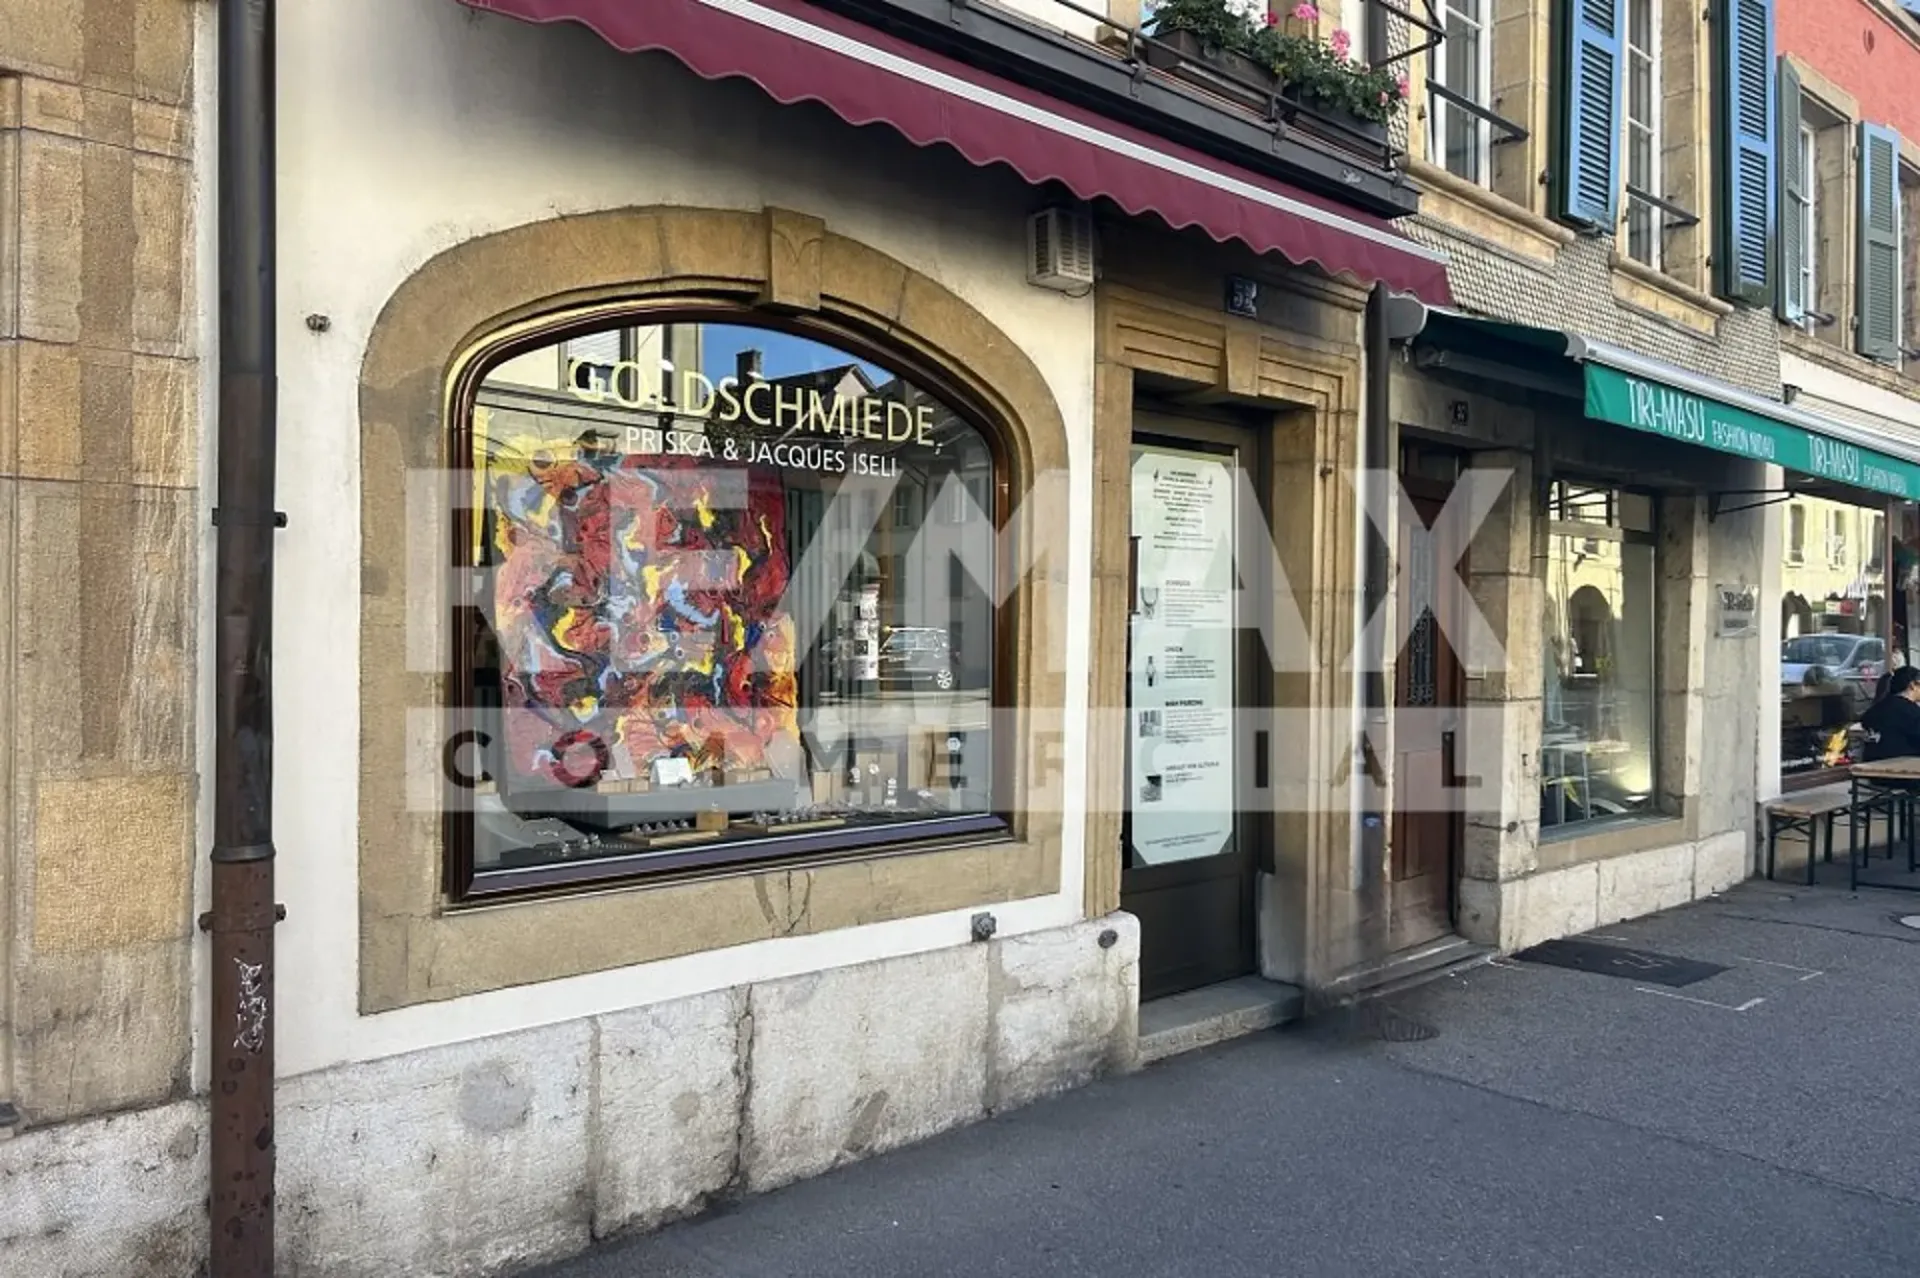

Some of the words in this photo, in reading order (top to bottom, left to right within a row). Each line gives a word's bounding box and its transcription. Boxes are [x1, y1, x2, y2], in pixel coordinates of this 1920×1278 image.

[625, 427, 714, 459] PRISKA
[723, 439, 738, 460] &
[747, 440, 845, 473] JACQUES
[853, 455, 897, 477] ISELI
